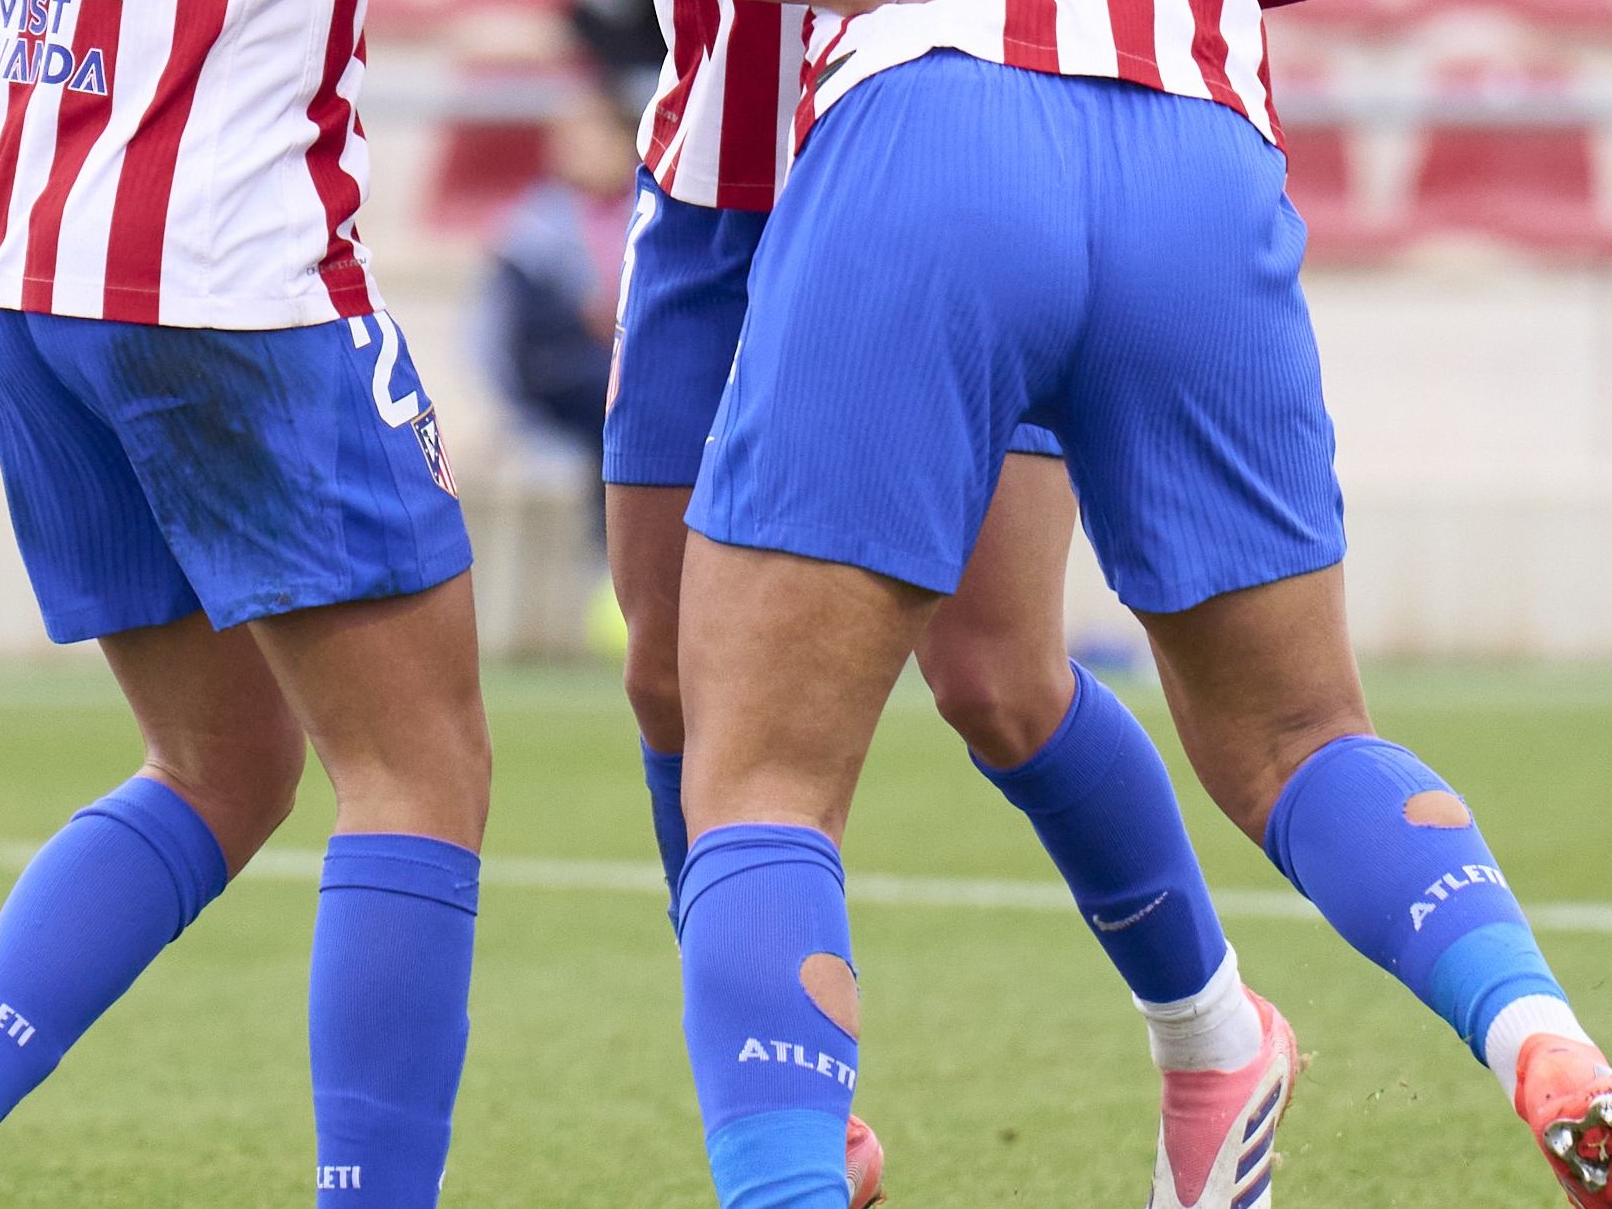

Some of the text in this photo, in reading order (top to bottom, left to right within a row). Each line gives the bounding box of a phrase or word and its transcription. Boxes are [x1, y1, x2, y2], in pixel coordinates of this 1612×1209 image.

[347, 308, 420, 429] 2
[1409, 864, 1508, 932] ATLETI
[738, 1037, 857, 1092] ATLETI
